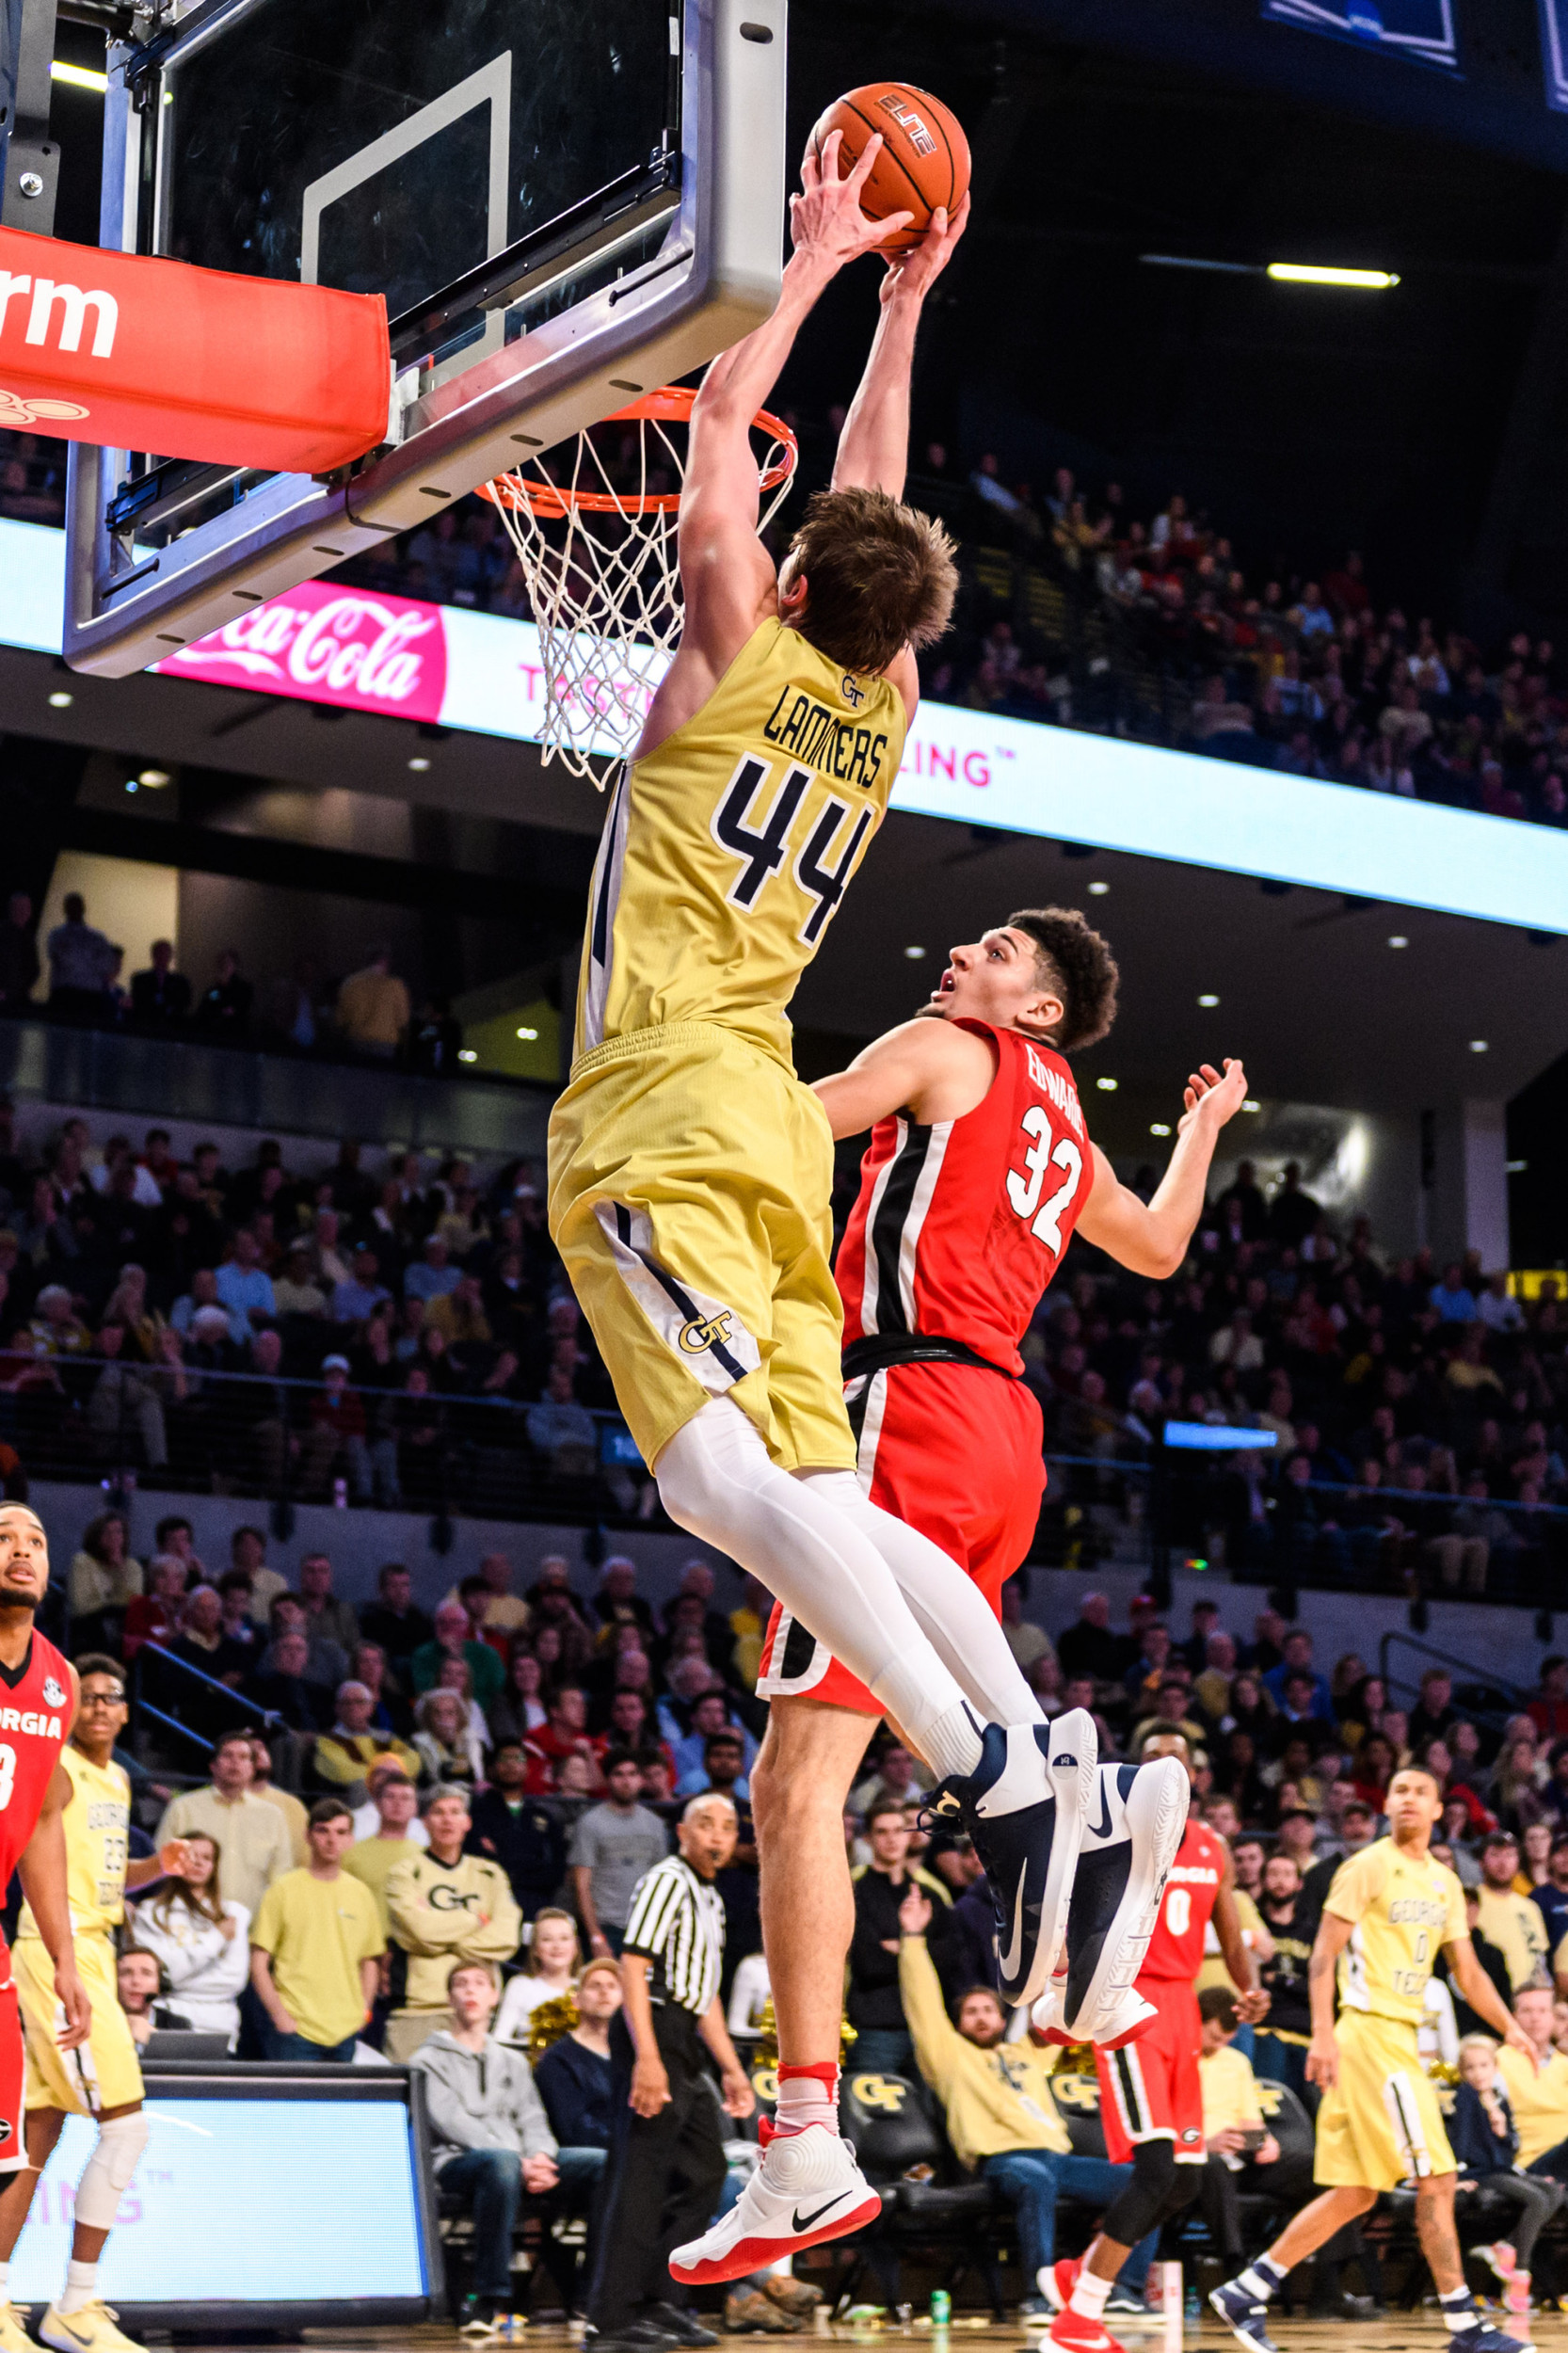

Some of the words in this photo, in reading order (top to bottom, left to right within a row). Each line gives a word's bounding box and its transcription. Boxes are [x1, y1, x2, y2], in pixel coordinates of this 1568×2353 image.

[878, 94, 937, 158] ELITE
[0, 269, 119, 359] rm
[841, 675, 864, 708] GT
[763, 684, 888, 789] LAMMERS
[709, 750, 876, 950] 44
[1006, 1105, 1083, 1260] 32
[678, 1310, 732, 1354] GT
[0, 1706, 62, 1740] RGIA
[1166, 1888, 1192, 1936] 0
[852, 2074, 906, 2111] GT
